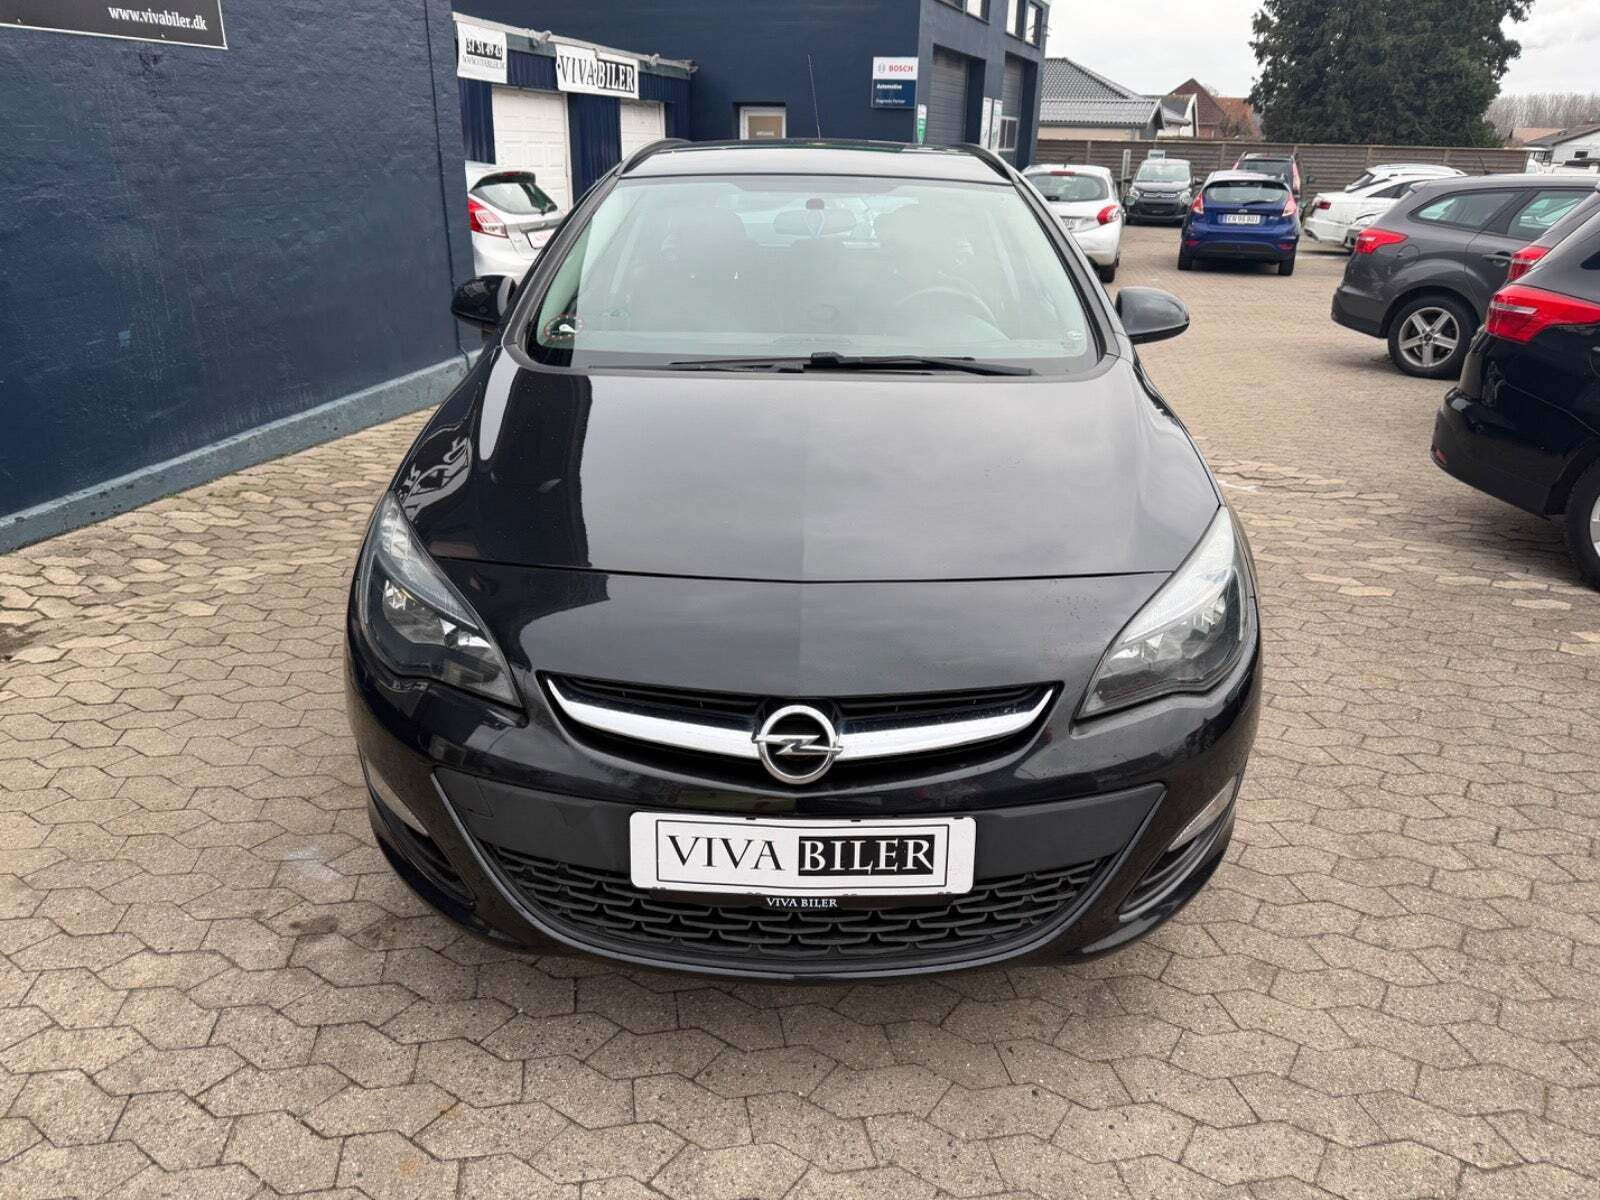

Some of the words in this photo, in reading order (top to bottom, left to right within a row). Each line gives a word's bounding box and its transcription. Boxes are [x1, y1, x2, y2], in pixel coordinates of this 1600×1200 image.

[108, 6, 208, 31] www.vivabiler.dk
[559, 55, 597, 88] VIVA
[597, 59, 635, 93] BILER
[888, 63, 914, 72] BOSCH
[666, 834, 786, 872] VIVA
[799, 838, 934, 875] BILER
[766, 897, 798, 908] VIVA
[801, 898, 838, 908] BILER
